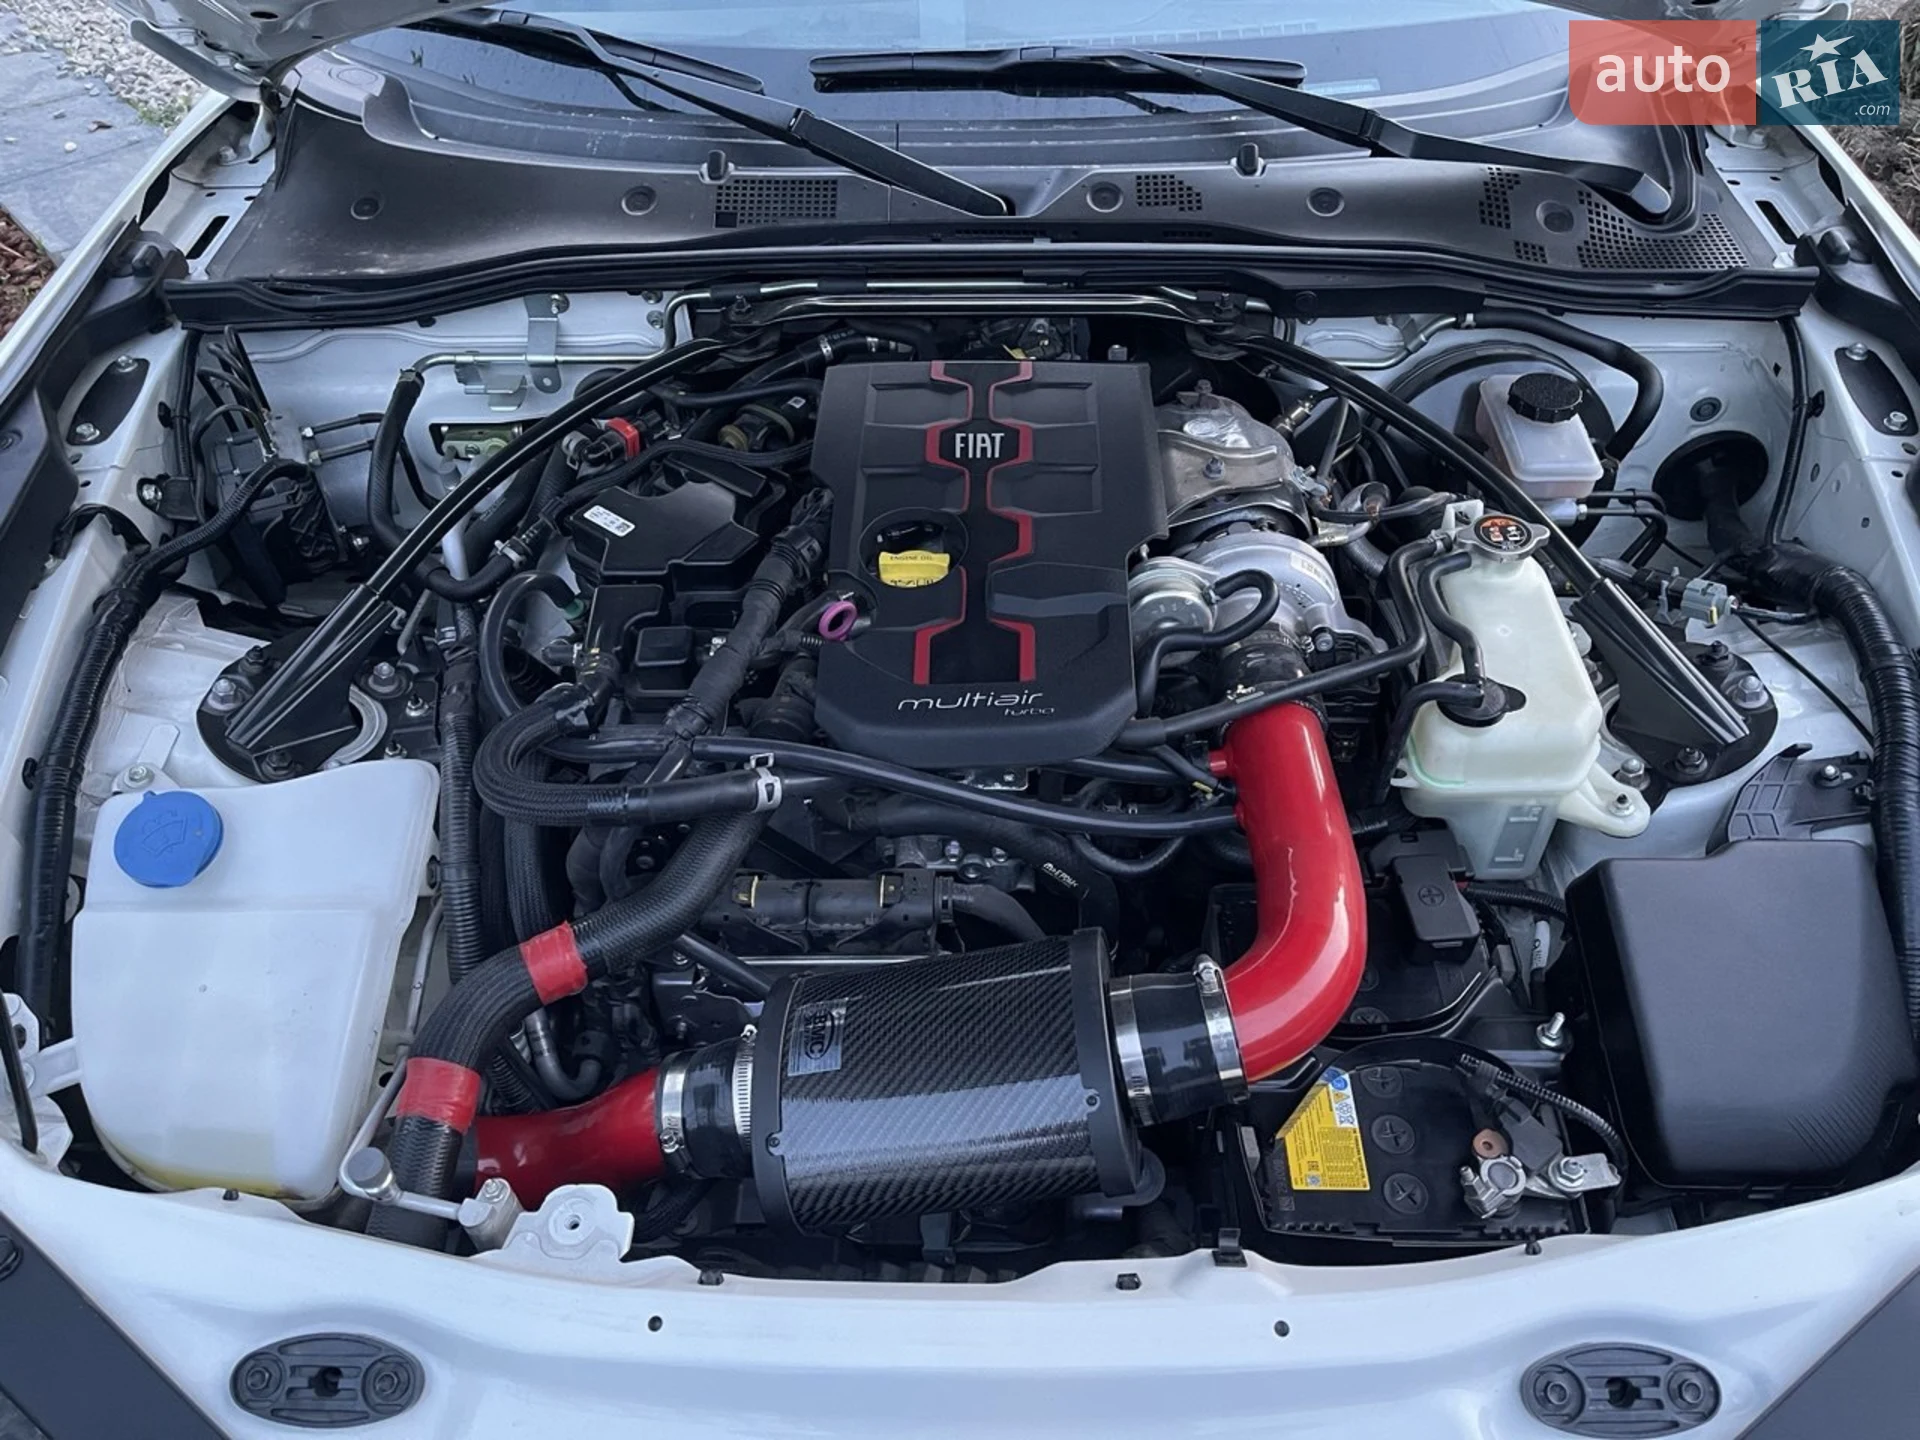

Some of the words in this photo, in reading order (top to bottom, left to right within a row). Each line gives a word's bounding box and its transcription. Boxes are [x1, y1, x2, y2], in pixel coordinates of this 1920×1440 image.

[955, 432, 1005, 458] FIAT
[898, 689, 1043, 710] multiair
[1004, 707, 1055, 716] turbo
[810, 1013, 828, 1054] BMC
